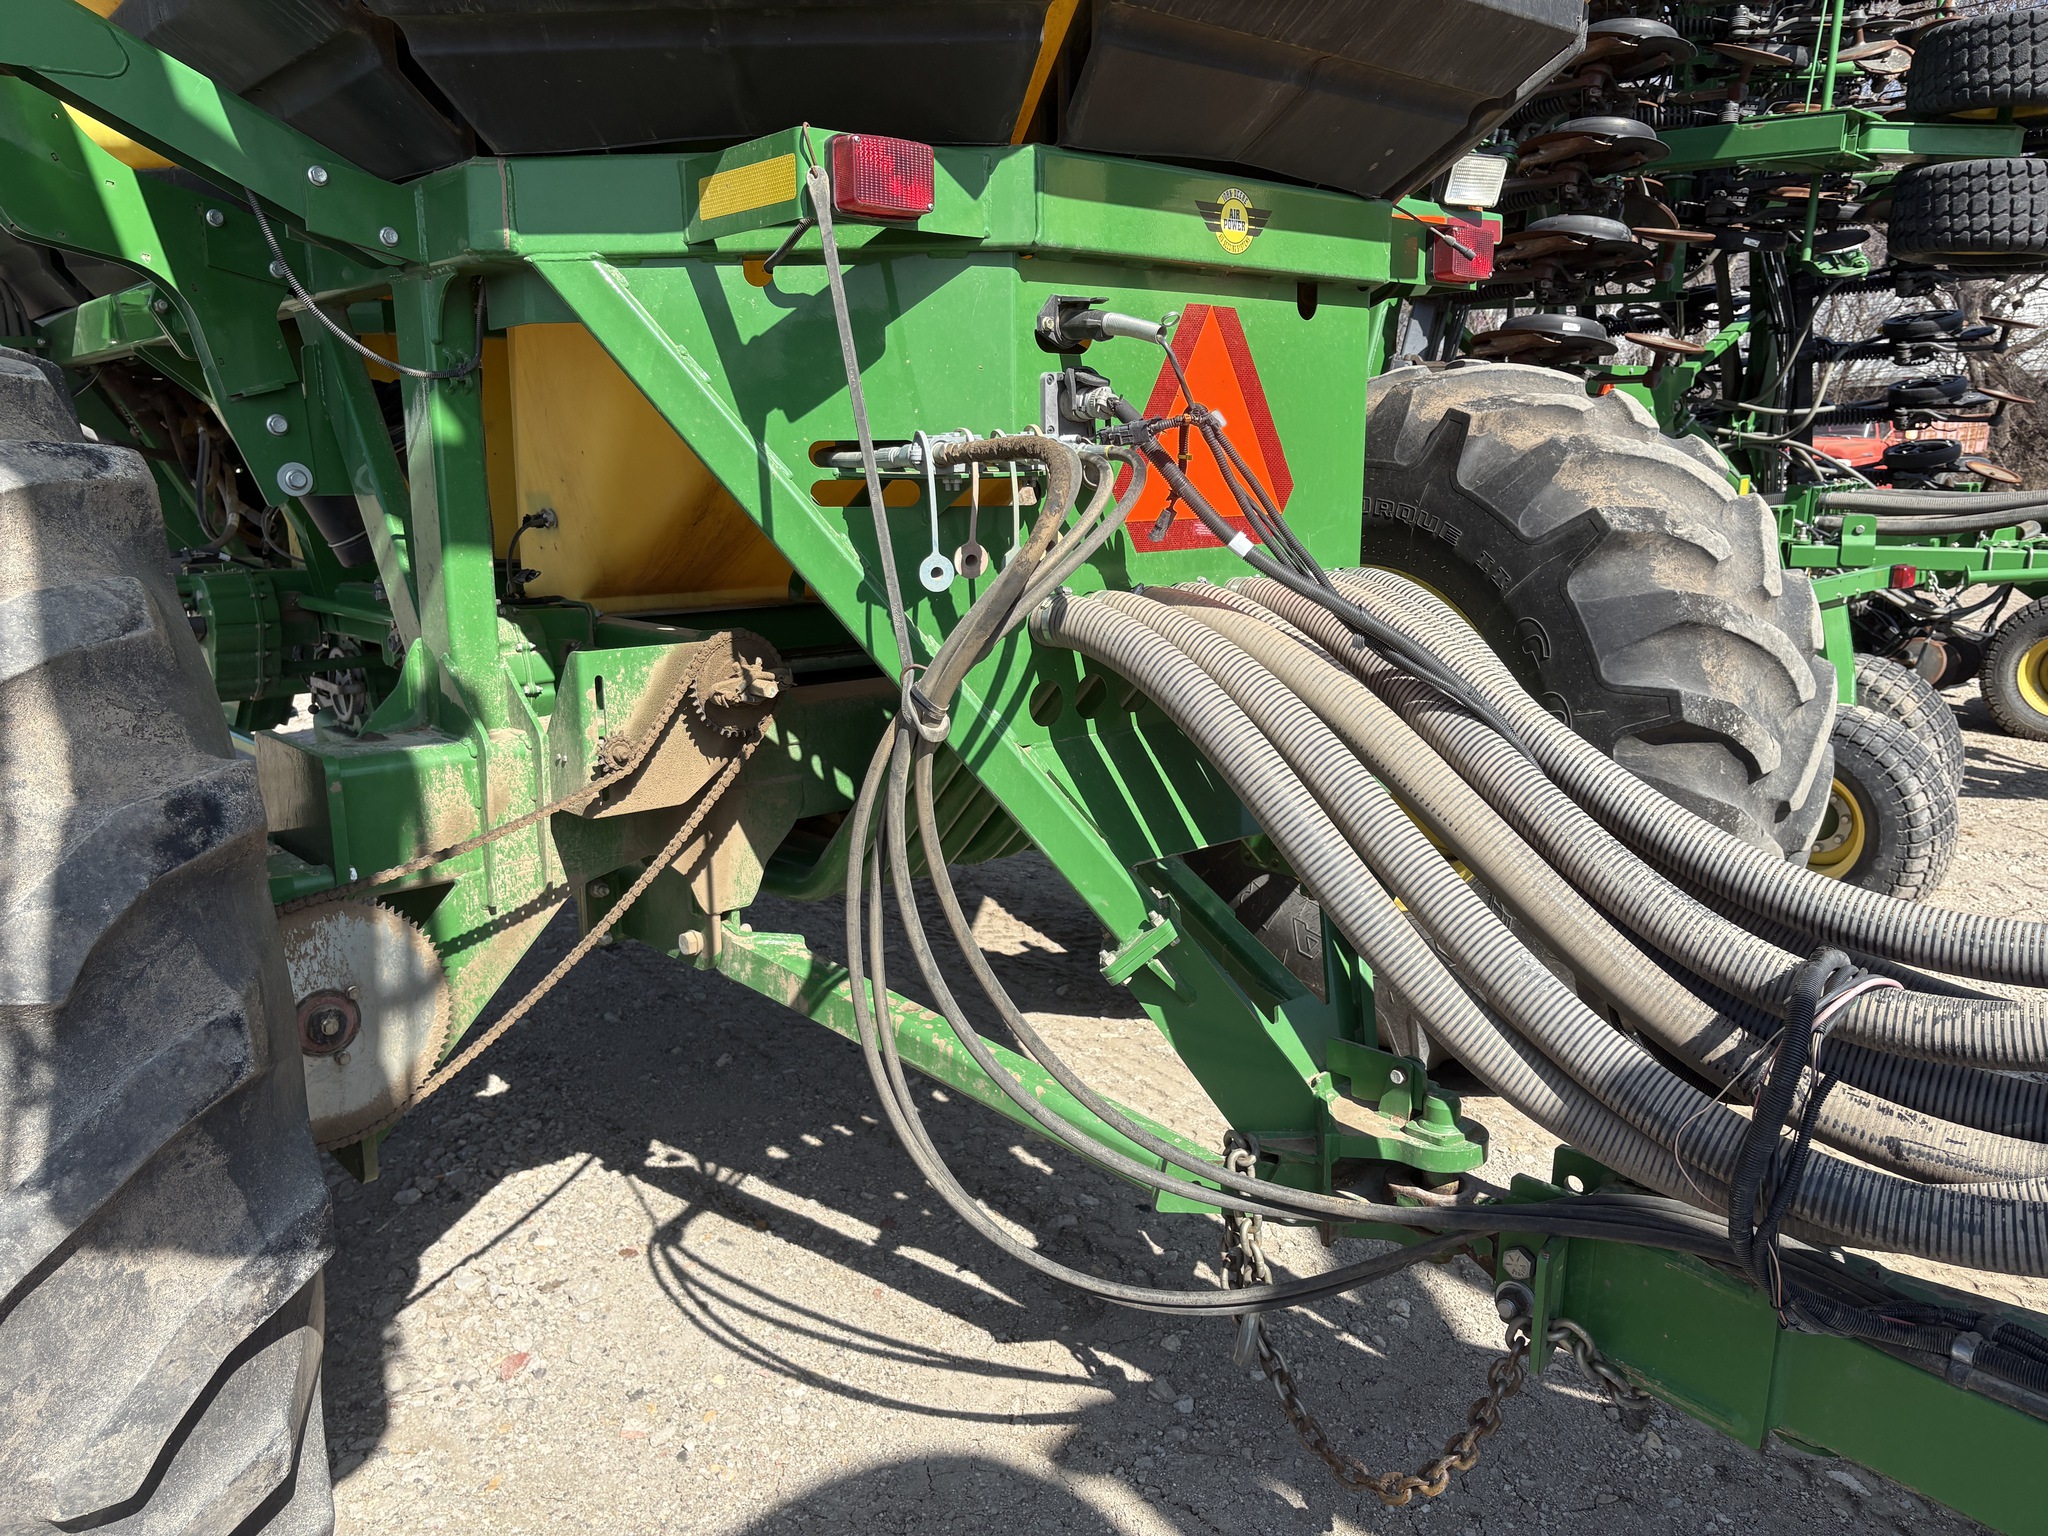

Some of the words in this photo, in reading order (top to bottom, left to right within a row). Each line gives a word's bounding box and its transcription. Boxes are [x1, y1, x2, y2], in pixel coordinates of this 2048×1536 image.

[1222, 190, 1232, 201] JOHN
[1234, 190, 1248, 205] DEERE
[1229, 208, 1240, 219] AIR
[1223, 219, 1246, 231] POWER
